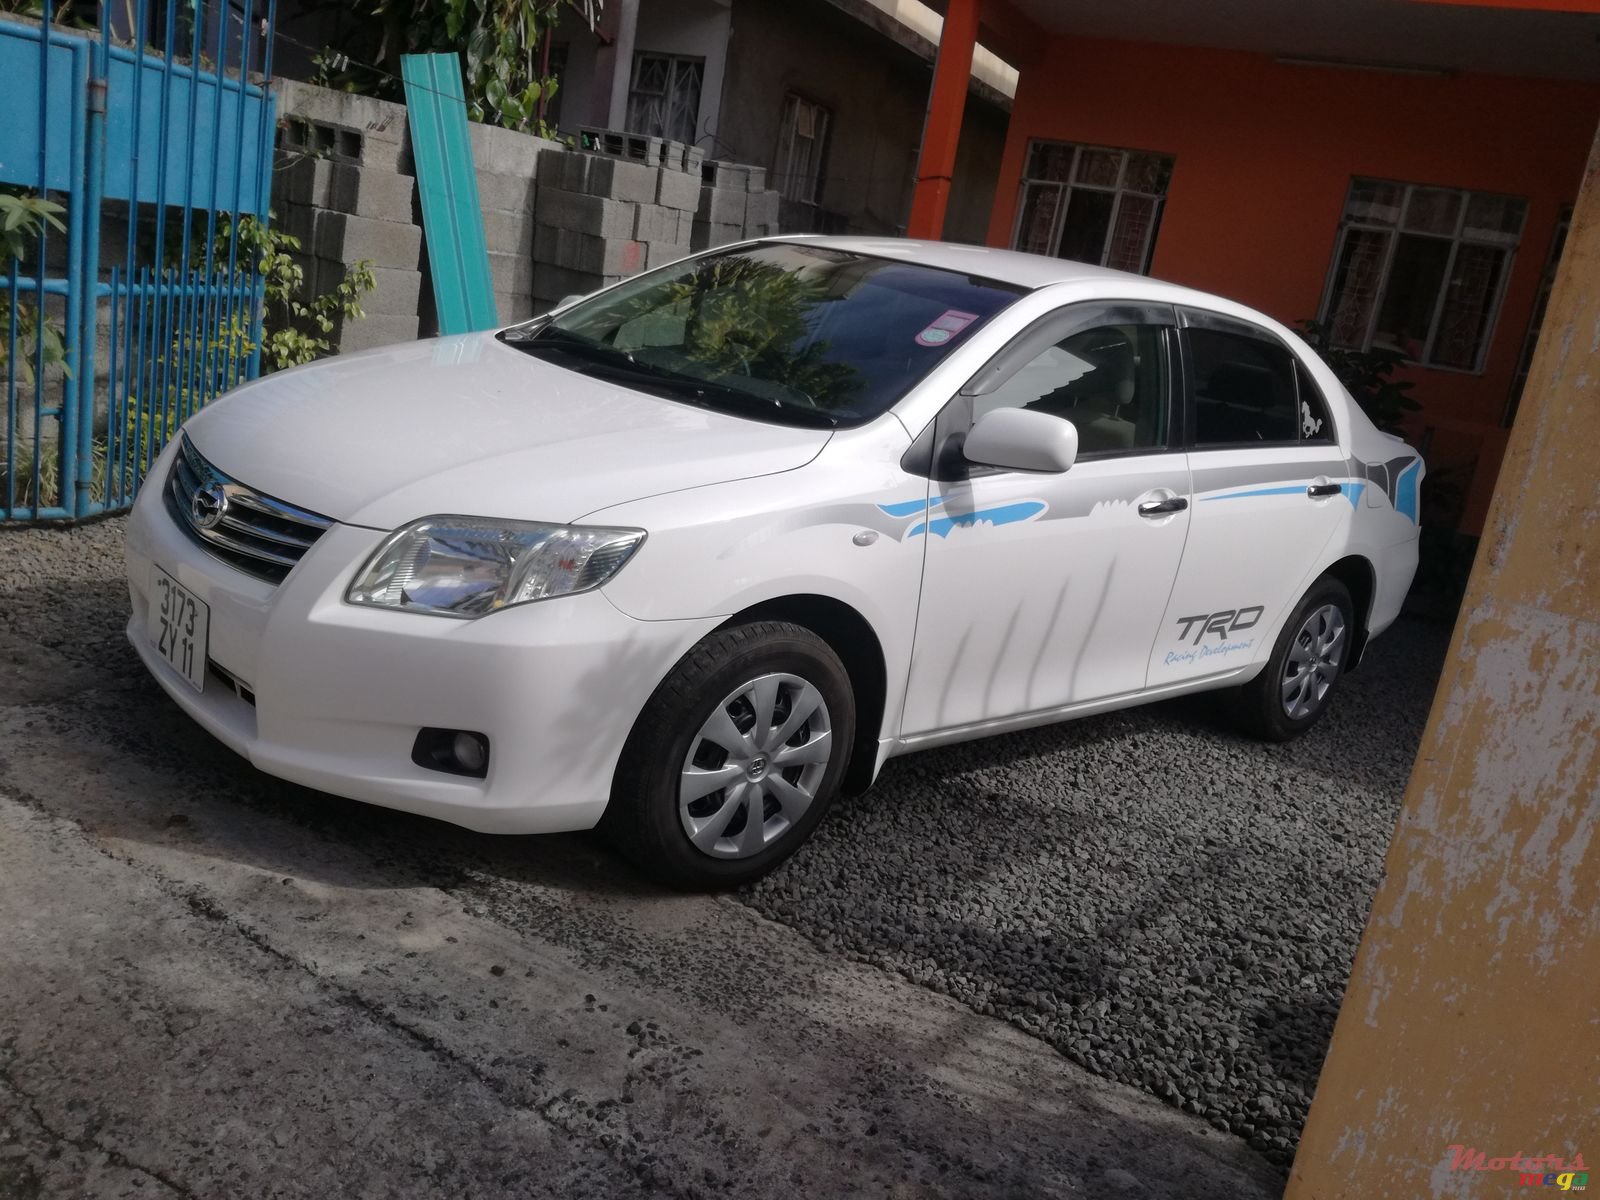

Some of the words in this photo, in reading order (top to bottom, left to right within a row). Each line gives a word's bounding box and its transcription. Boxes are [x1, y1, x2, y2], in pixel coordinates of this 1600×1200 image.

[160, 578, 196, 637] 3173
[1176, 605, 1264, 646] TRD
[158, 615, 178, 663] ZY
[182, 637, 194, 680] 11
[1164, 650, 1198, 666] Racing
[1199, 638, 1255, 658] Development
